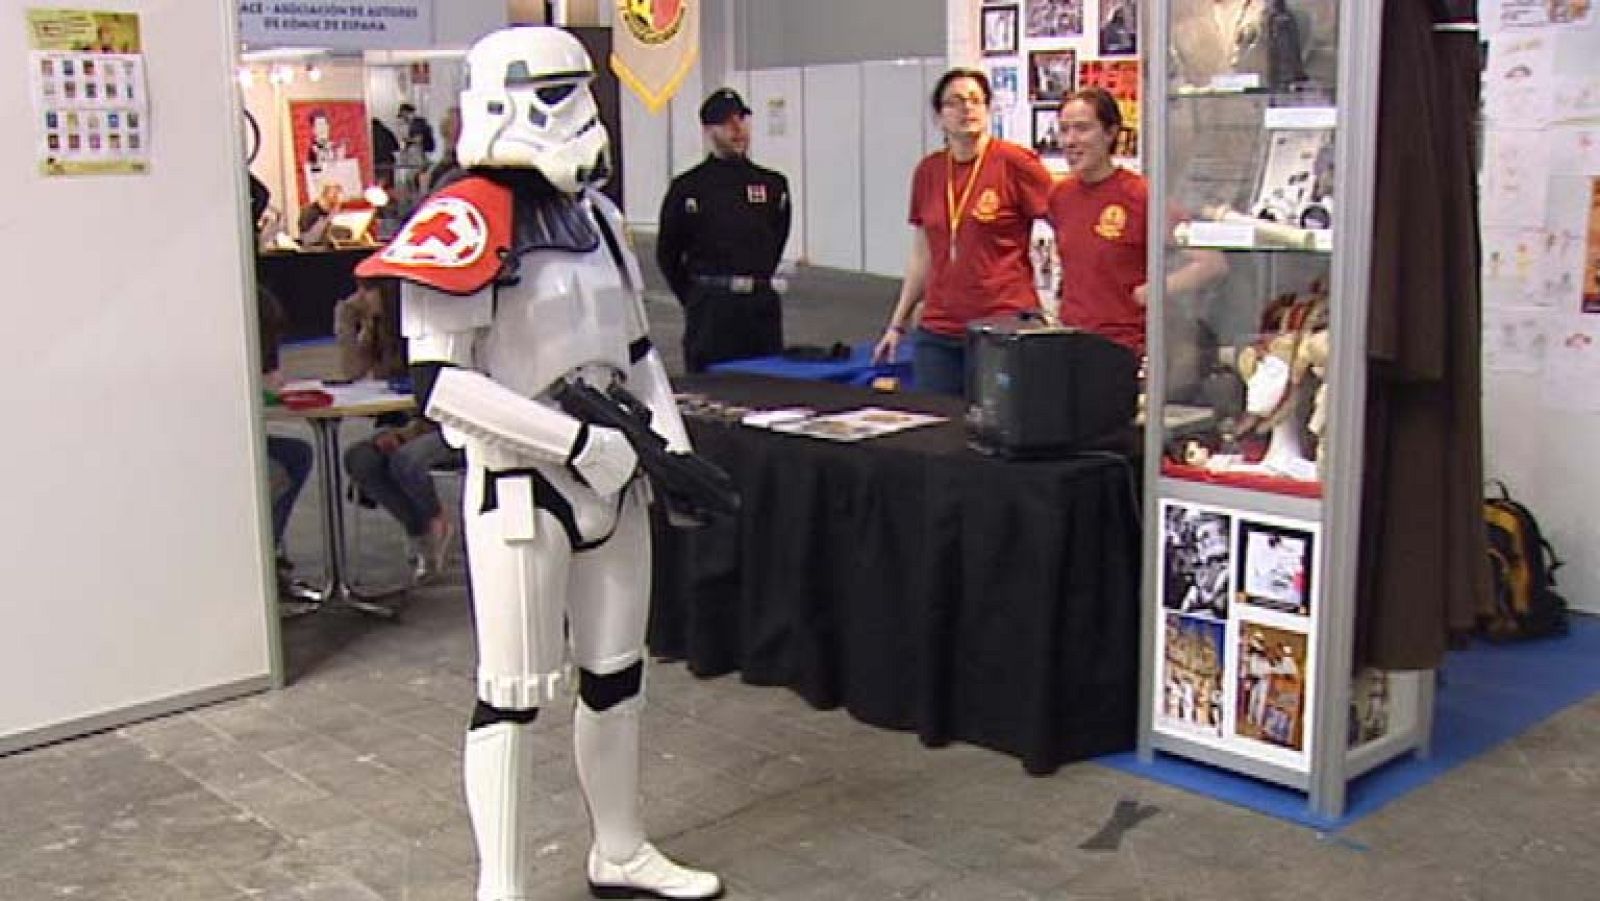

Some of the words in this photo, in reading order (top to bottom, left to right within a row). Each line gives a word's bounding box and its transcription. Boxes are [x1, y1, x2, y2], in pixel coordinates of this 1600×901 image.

[349, 6, 363, 17] DE
[368, 6, 418, 18] AUTORES
[264, 16, 279, 28] DE
[324, 19, 338, 30] DE
